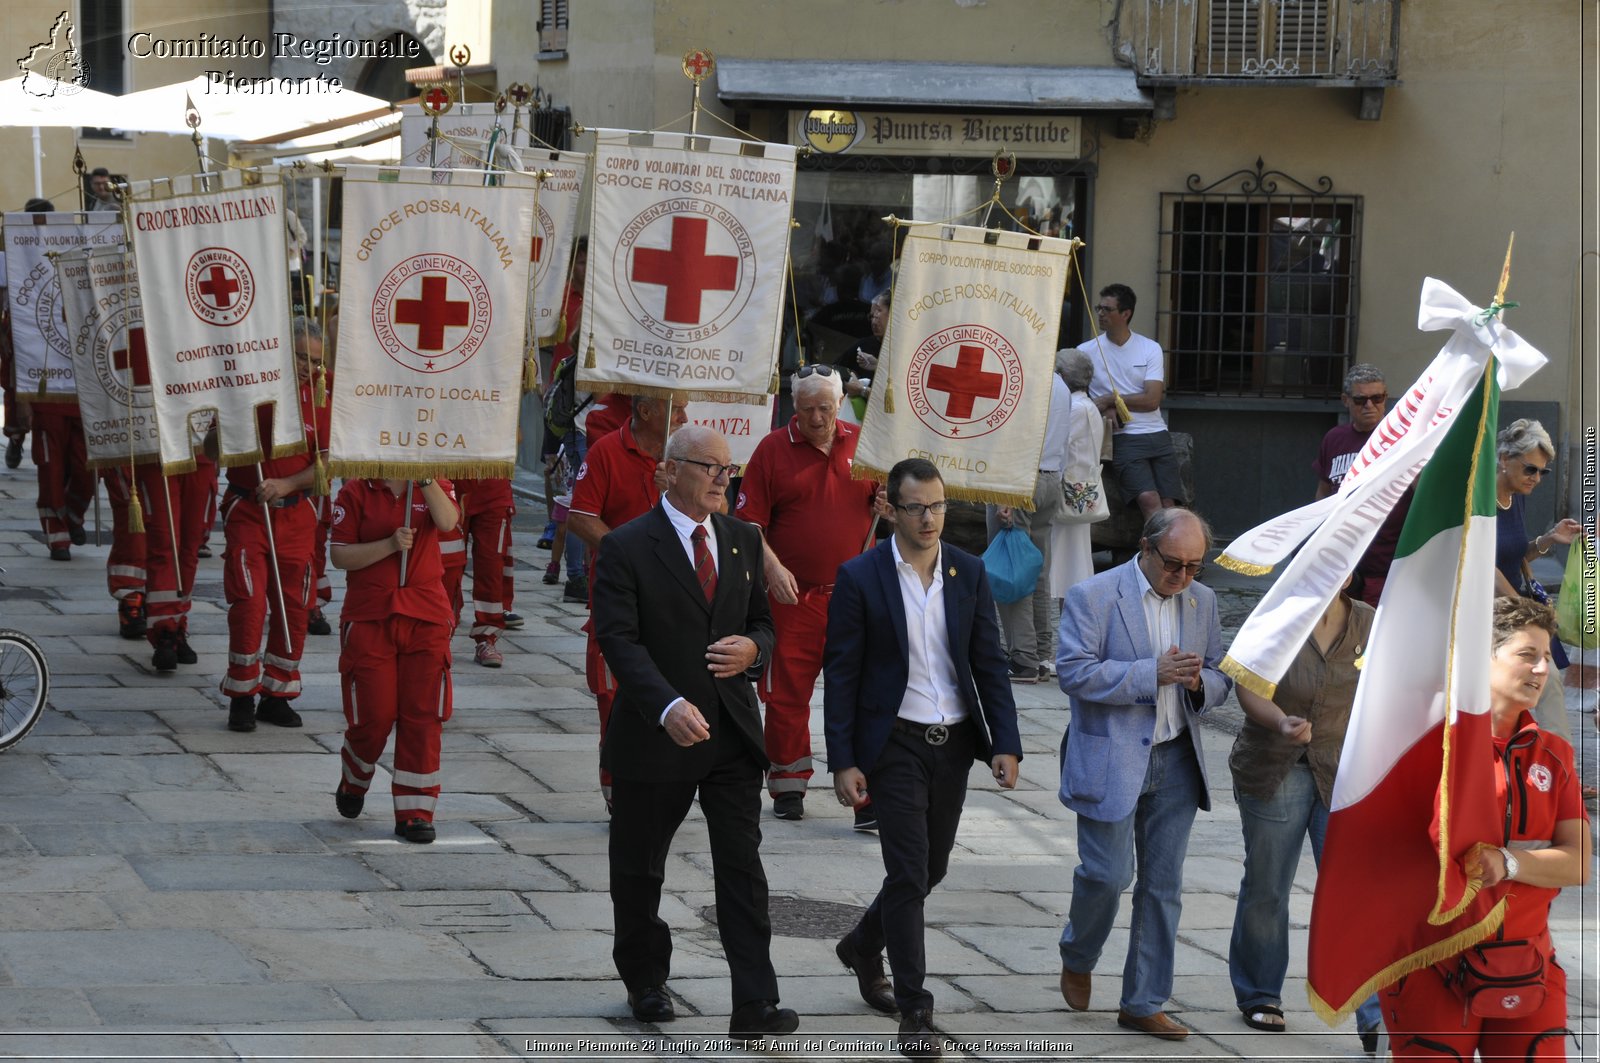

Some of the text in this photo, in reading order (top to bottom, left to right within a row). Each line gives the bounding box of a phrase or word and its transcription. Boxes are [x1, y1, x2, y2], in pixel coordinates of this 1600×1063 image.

[872, 116, 1070, 144] Puntsa Bierstube
[606, 156, 781, 185] CORPO VOLONTARI DEL SOCCORSO
[595, 172, 788, 203] CROCE ROSSA ITALIANA
[136, 196, 277, 232] CROCE ROSSA ITALIANA
[13, 236, 40, 246] CORPO
[43, 235, 88, 246] VOLONTARI
[92, 235, 108, 245] DEL
[357, 200, 514, 270] CROCE ROSSA ITALIANA
[620, 200, 753, 259] CONVENZIONE DI GINEVRA
[192, 261, 200, 271] DI
[198, 252, 232, 264] GINEVRA
[232, 259, 241, 270] 22
[239, 269, 250, 301] AGOSTO
[919, 252, 1053, 278] CORPO VOLONTARI DEL SOCCORSO
[16, 262, 49, 306] CROCE
[375, 257, 489, 357] CONVENZIONE DI GINEVRA 22 AGOSTO 1864
[908, 283, 1046, 335] CROCE ROSSA ITALIANA
[76, 286, 140, 356] CROCE ROSS
[105, 322, 117, 335] DI
[176, 337, 279, 363] COMITATO LOCALE
[612, 338, 743, 363] DELEGAZIONE DI
[223, 359, 237, 371] DI
[616, 354, 735, 381] PEVERAGNO
[910, 328, 1021, 428] CONVENZIONE DI GINEVRA 22 AGOSTO 1864
[165, 375, 235, 396] SOMMARIVA
[235, 373, 259, 387] DEL
[355, 384, 500, 402] COMITATO LOCALE
[93, 415, 146, 432] COMITATO
[417, 408, 434, 423] DI
[88, 431, 129, 446] BORGO
[379, 430, 467, 449] BUSCA
[907, 448, 987, 474] CENTALLO
